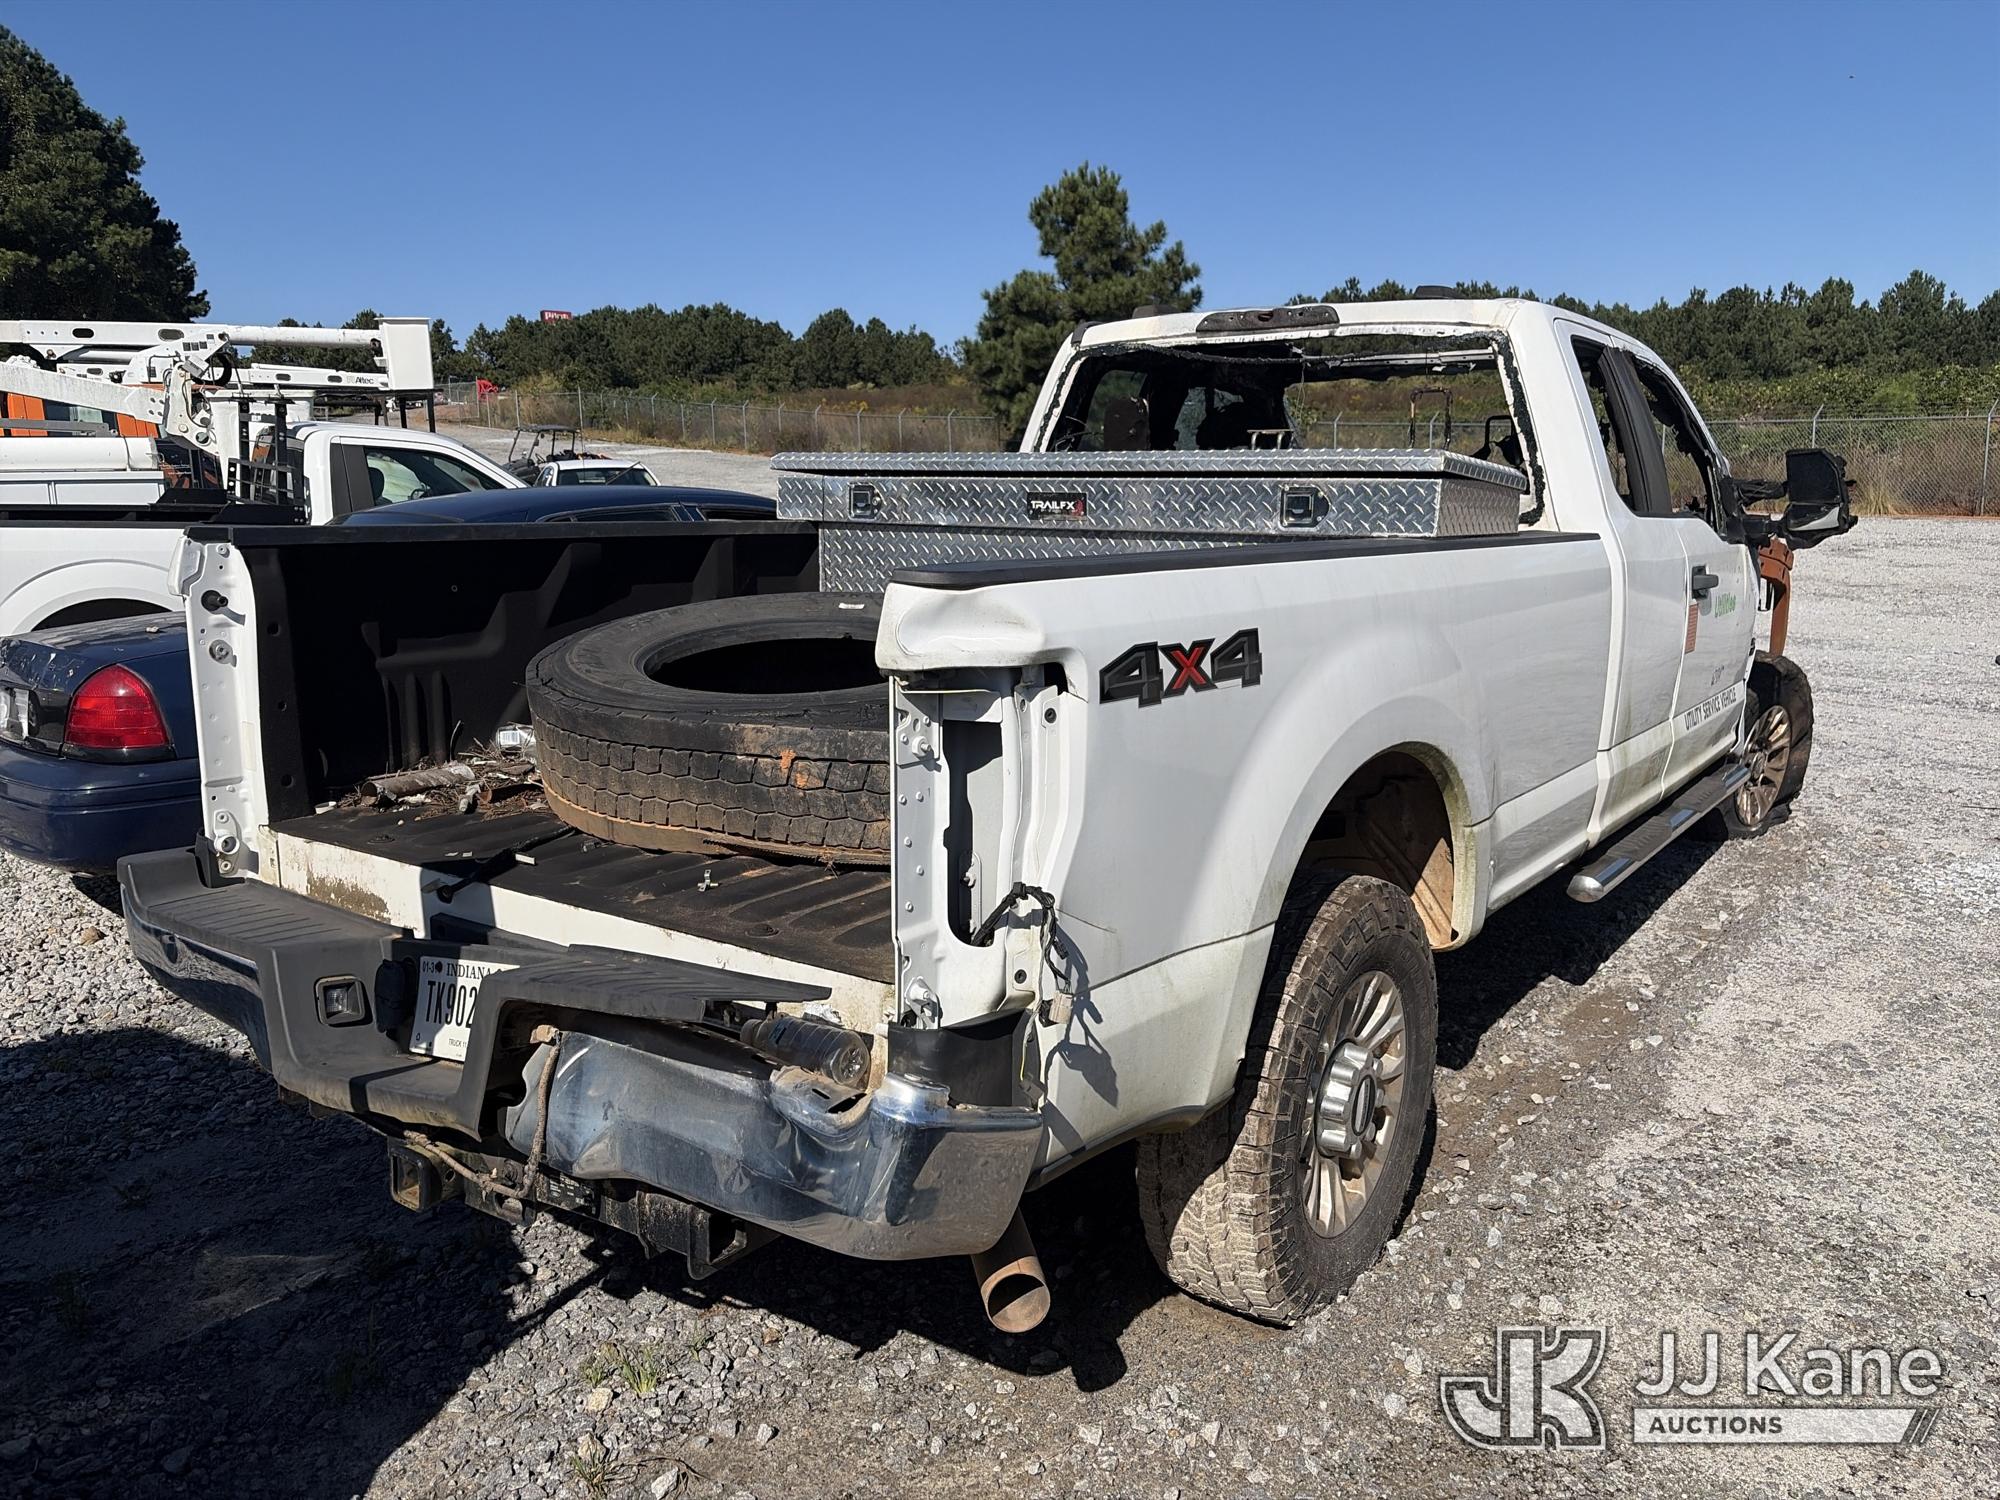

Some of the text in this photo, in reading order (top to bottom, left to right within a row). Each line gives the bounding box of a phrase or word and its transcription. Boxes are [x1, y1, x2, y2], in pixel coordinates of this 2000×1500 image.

[1030, 500, 1076, 510] TRAILFX
[1684, 686, 1737, 730] UTILITY SERVICE VEHICLE
